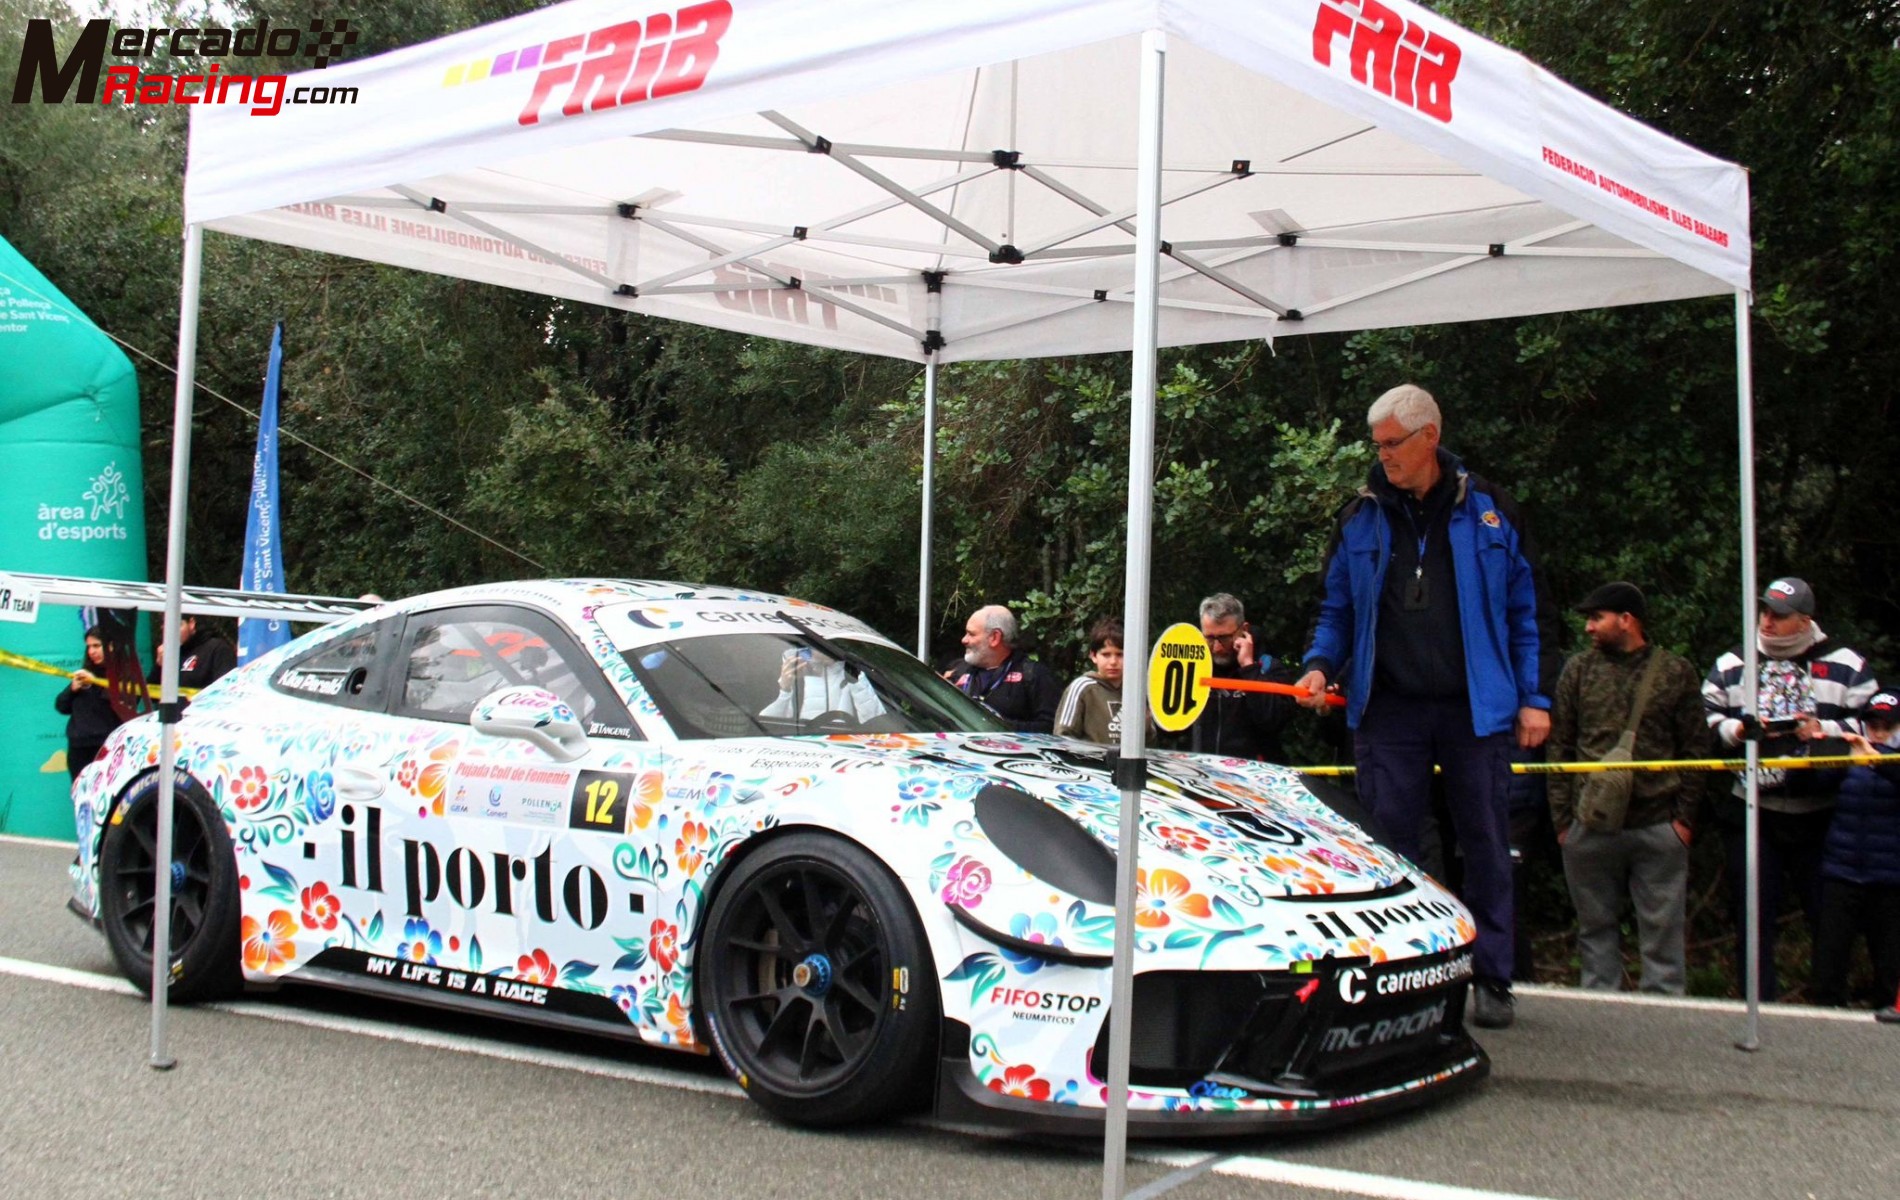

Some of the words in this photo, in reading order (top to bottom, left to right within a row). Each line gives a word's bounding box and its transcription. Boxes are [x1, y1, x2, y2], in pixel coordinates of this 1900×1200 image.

[1599, 174, 1671, 221] AUTOMOBILISME
[1671, 209, 1693, 232] ILLES
[1694, 220, 1729, 248] BALEARS
[10, 310, 36, 320] Sant
[37, 503, 85, 521] àrea
[38, 522, 127, 542] d'esports
[262, 549, 273, 578] Sant
[13, 598, 34, 613] TEAM
[1160, 641, 1206, 660] SEGUNDOS
[1161, 660, 1198, 717] 10
[510, 767, 525, 781] de
[585, 779, 619, 825] 12
[340, 804, 386, 894] il
[401, 834, 608, 931] porto
[1306, 911, 1358, 940] il
[1354, 898, 1455, 935] porto
[366, 956, 397, 976] MY
[401, 962, 442, 985] LIFE
[447, 971, 468, 990] IS
[471, 977, 487, 993] A
[493, 981, 549, 1005] RACE
[990, 987, 1101, 1014] FIFOSTOP
[1012, 1011, 1075, 1025] NEUMATICOS
[1320, 1022, 1370, 1052] MC
